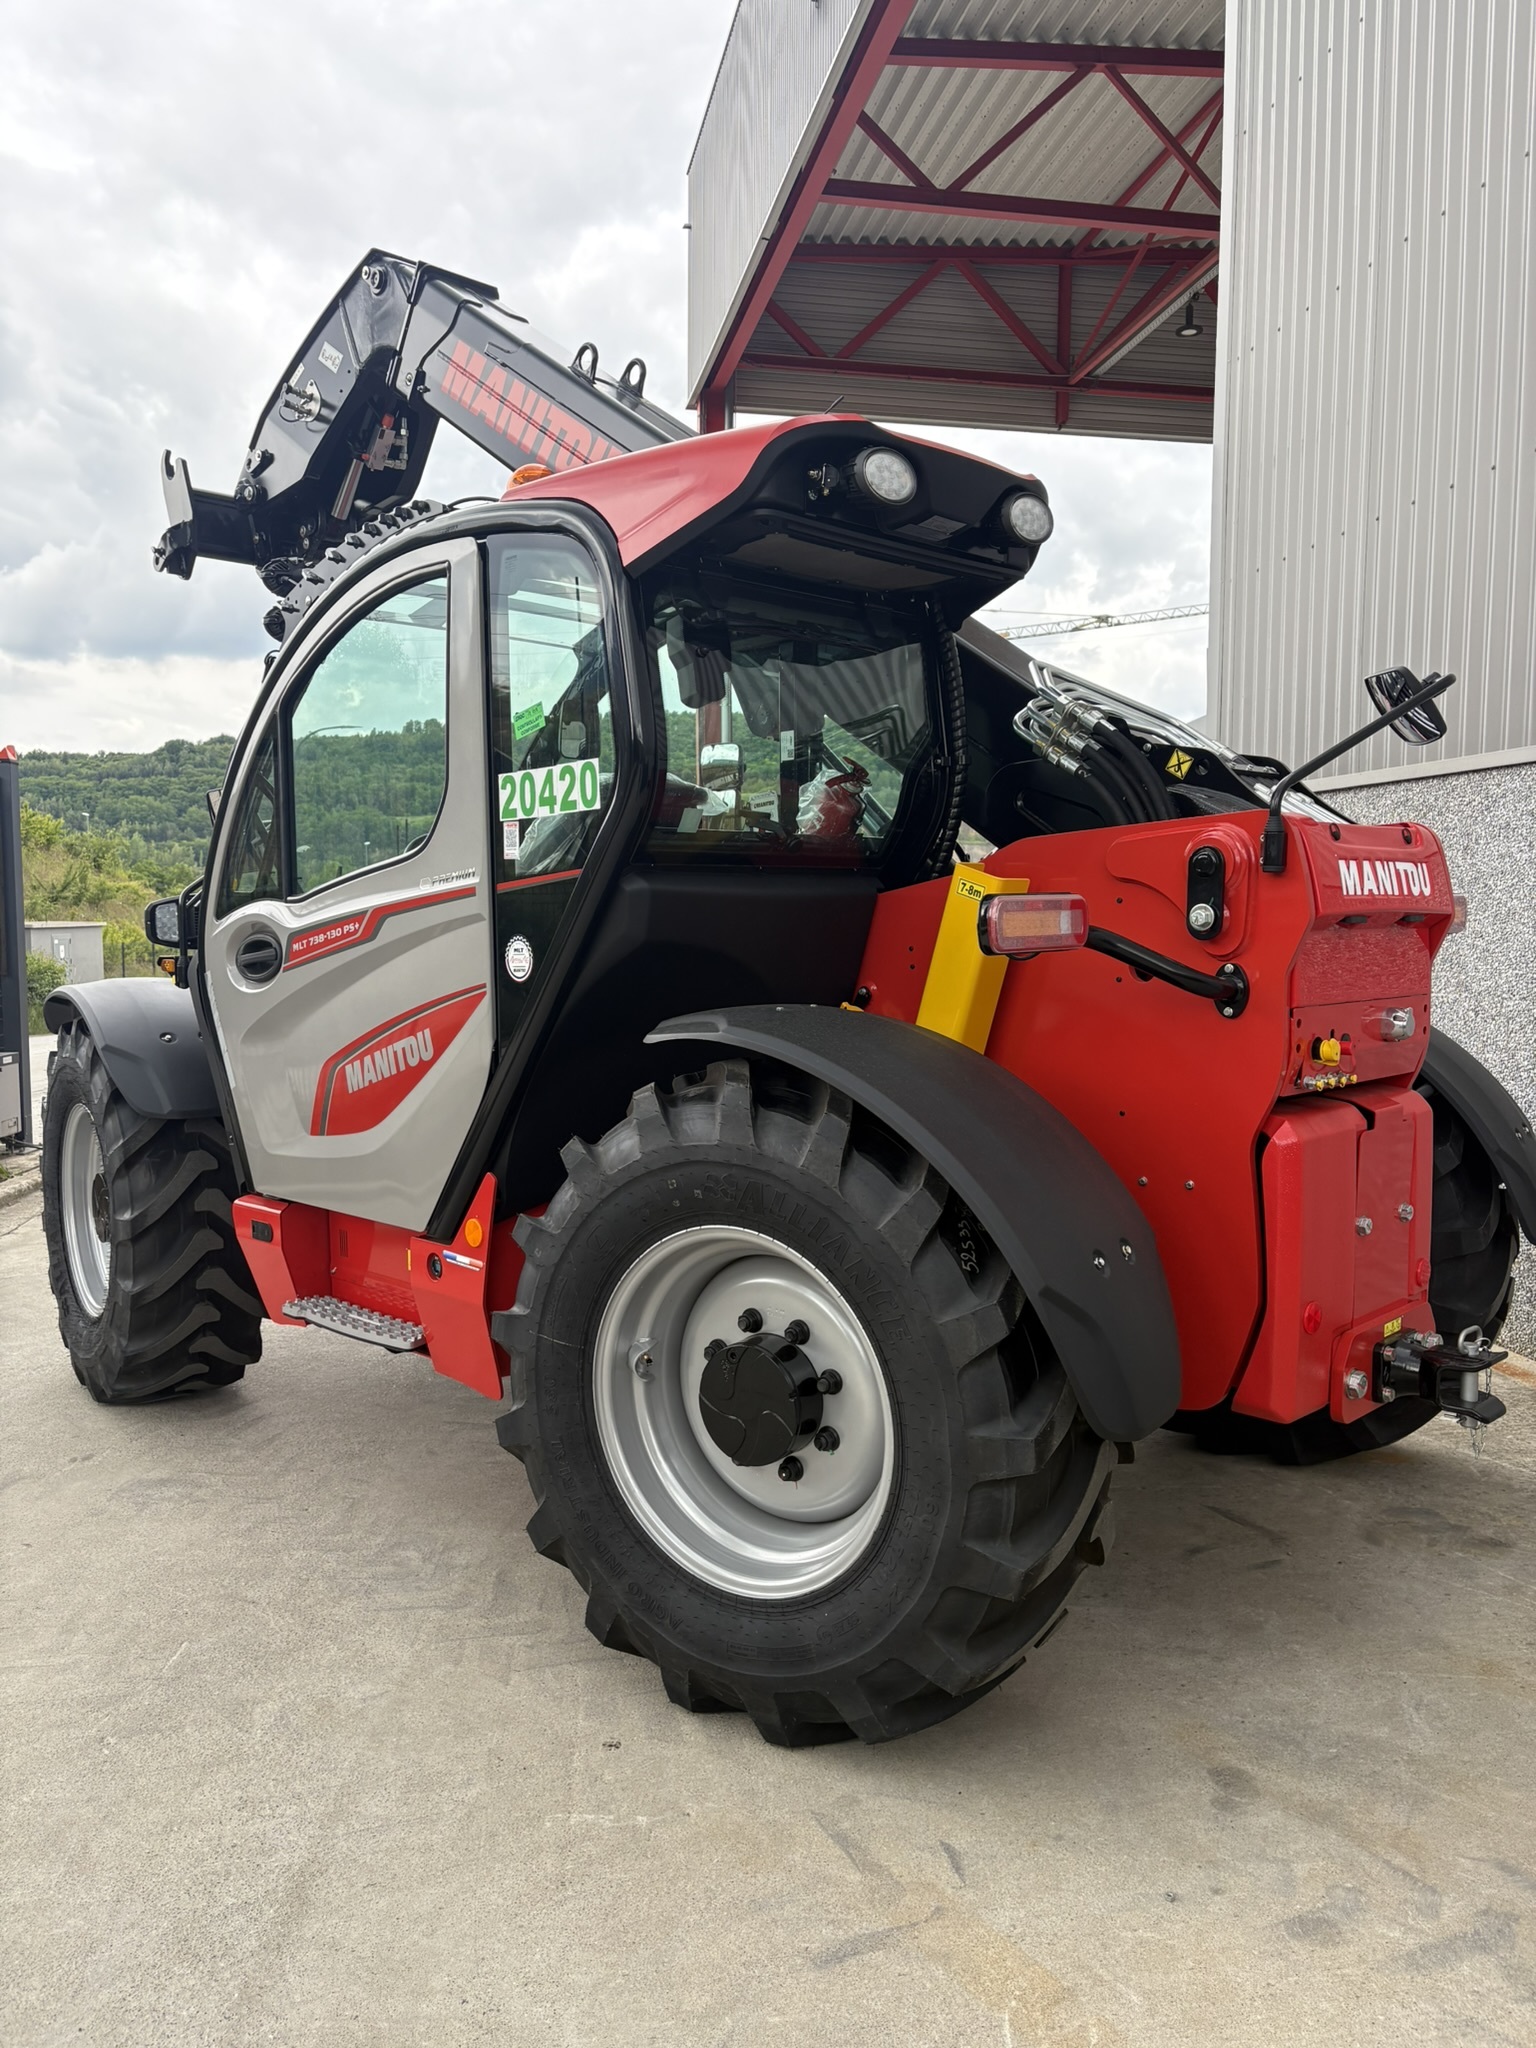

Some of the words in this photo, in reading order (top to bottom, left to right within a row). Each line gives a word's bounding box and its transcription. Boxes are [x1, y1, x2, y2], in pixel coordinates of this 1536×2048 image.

[500, 761, 598, 820] 20420
[432, 867, 476, 887] PREMIUM
[961, 882, 982, 899] 7-8m
[1338, 859, 1431, 897] MANITOU
[292, 939, 308, 952] MLT
[308, 927, 342, 947] 738-130
[343, 921, 360, 935] PS+
[345, 1027, 434, 1094] MANITOU
[735, 1177, 912, 1344] ALLIANCE
